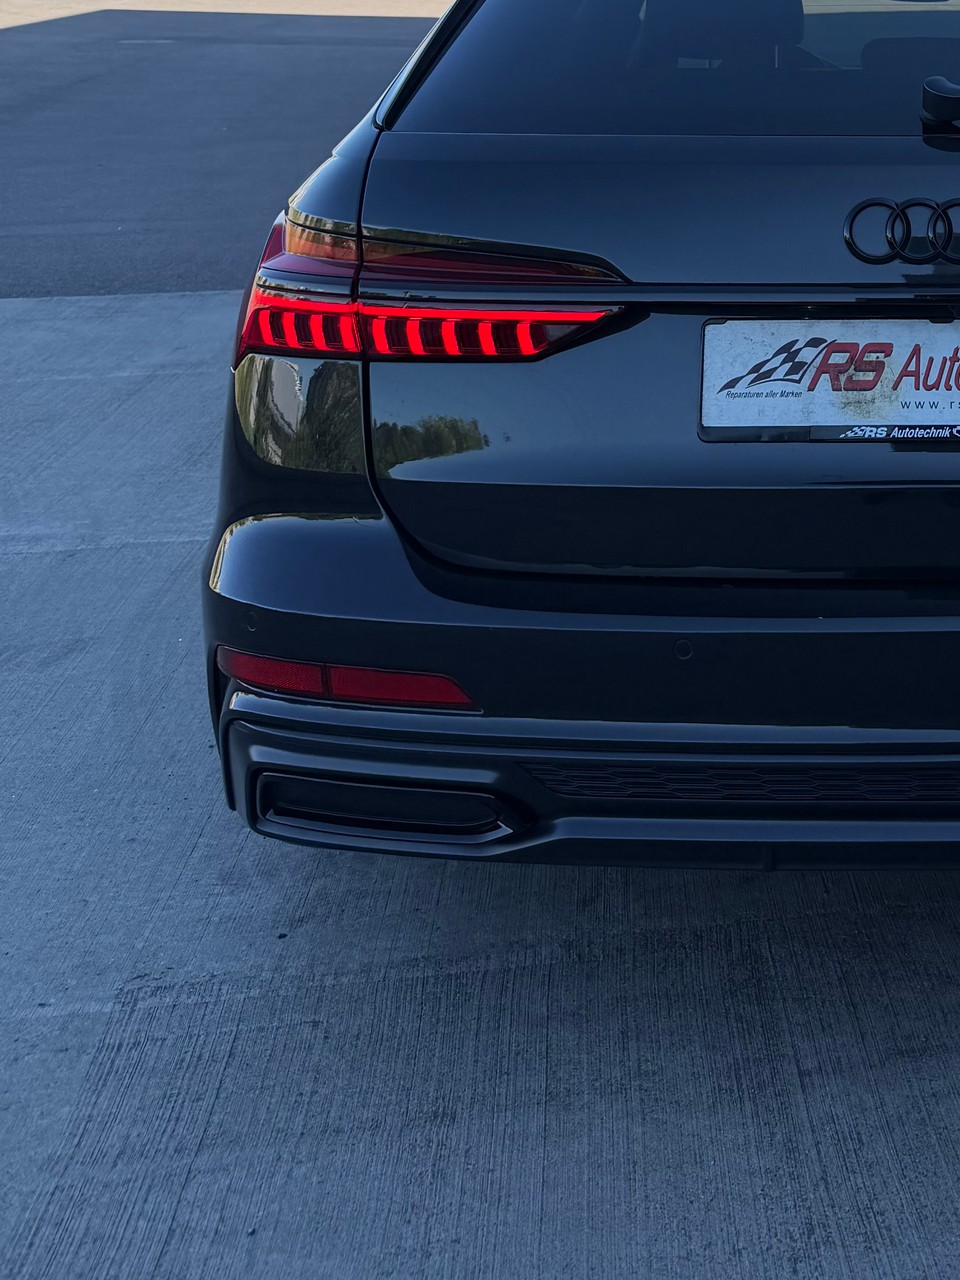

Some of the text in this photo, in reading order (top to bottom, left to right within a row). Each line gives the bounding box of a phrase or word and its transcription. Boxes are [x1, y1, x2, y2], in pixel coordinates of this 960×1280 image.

[806, 341, 894, 392] RS
[725, 389, 803, 400] Reparaturen aller Marken
[865, 427, 888, 439] RS
[889, 426, 951, 439] Autotechnik
